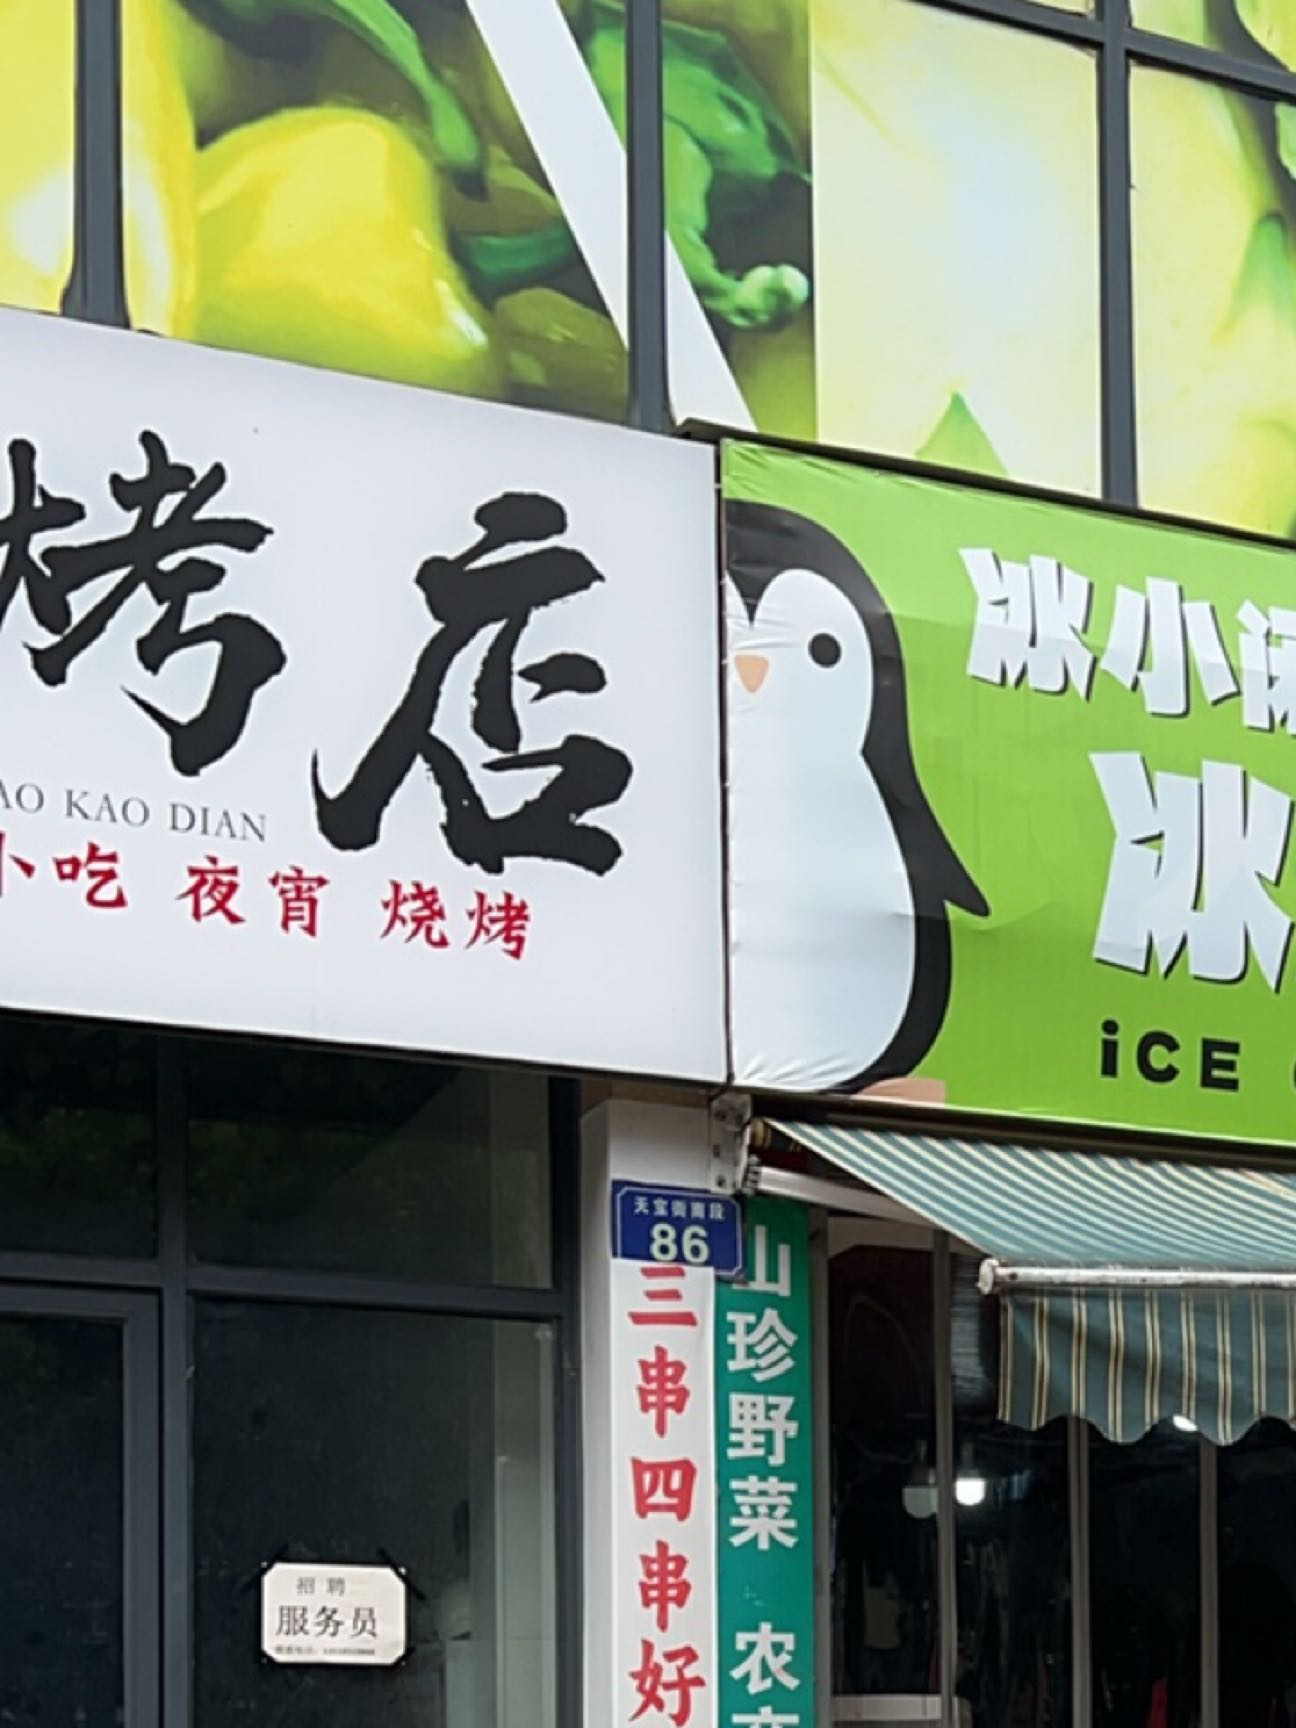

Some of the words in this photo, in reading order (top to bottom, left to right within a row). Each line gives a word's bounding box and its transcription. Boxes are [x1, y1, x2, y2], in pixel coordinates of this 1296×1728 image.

[65, 789, 150, 826] KAO
[170, 802, 266, 842] DIAN
[176, 855, 330, 938] 夜宵
[380, 880, 531, 960] 烧烤
[650, 1222, 709, 1264] 86
[727, 1224, 799, 1550] 山珍野菜
[296, 1576, 346, 1596] 招聘
[276, 1605, 377, 1639] 服务员
